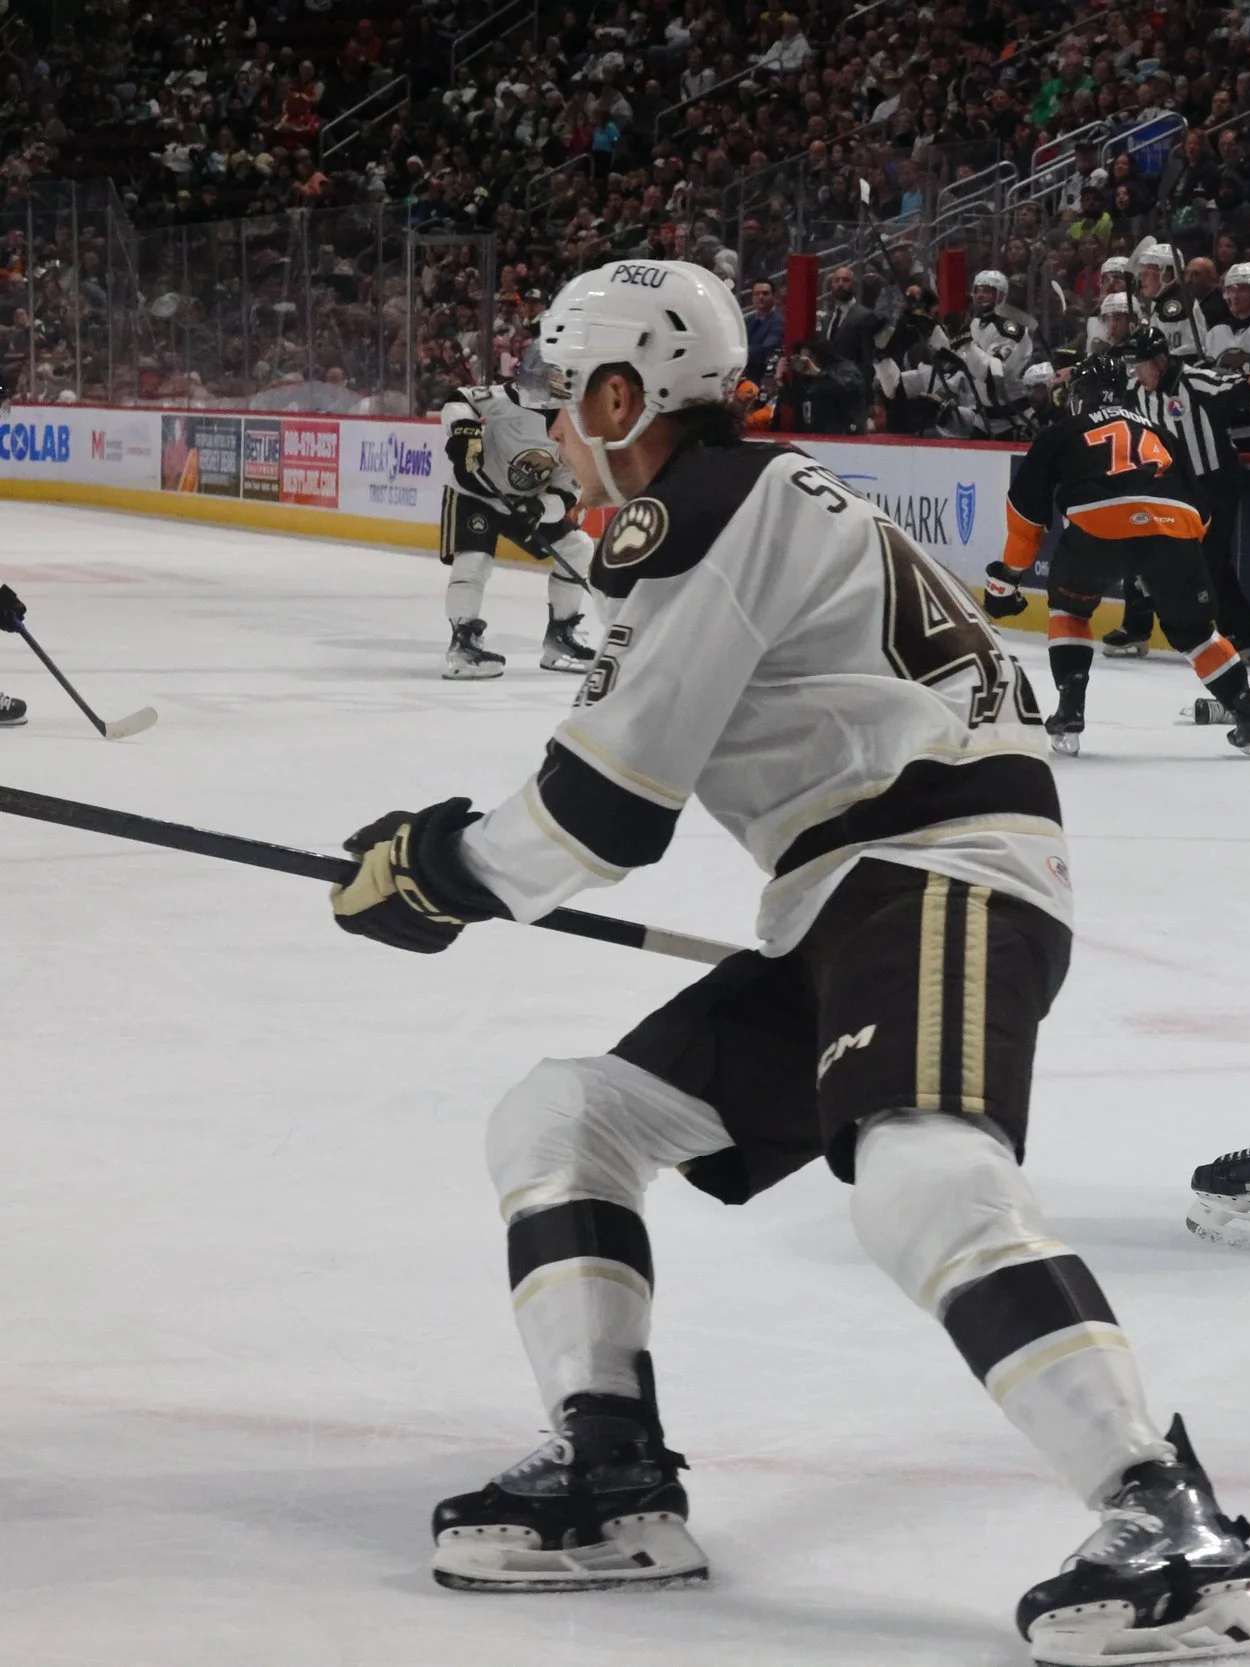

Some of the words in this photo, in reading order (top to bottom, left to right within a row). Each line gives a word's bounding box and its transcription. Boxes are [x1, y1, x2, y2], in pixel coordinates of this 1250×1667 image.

[611, 264, 668, 288] PSECU
[1102, 390, 1114, 403] 74
[1088, 404, 1153, 427] WISDOM
[398, 441, 432, 477] Lewis
[1083, 419, 1173, 478] 74
